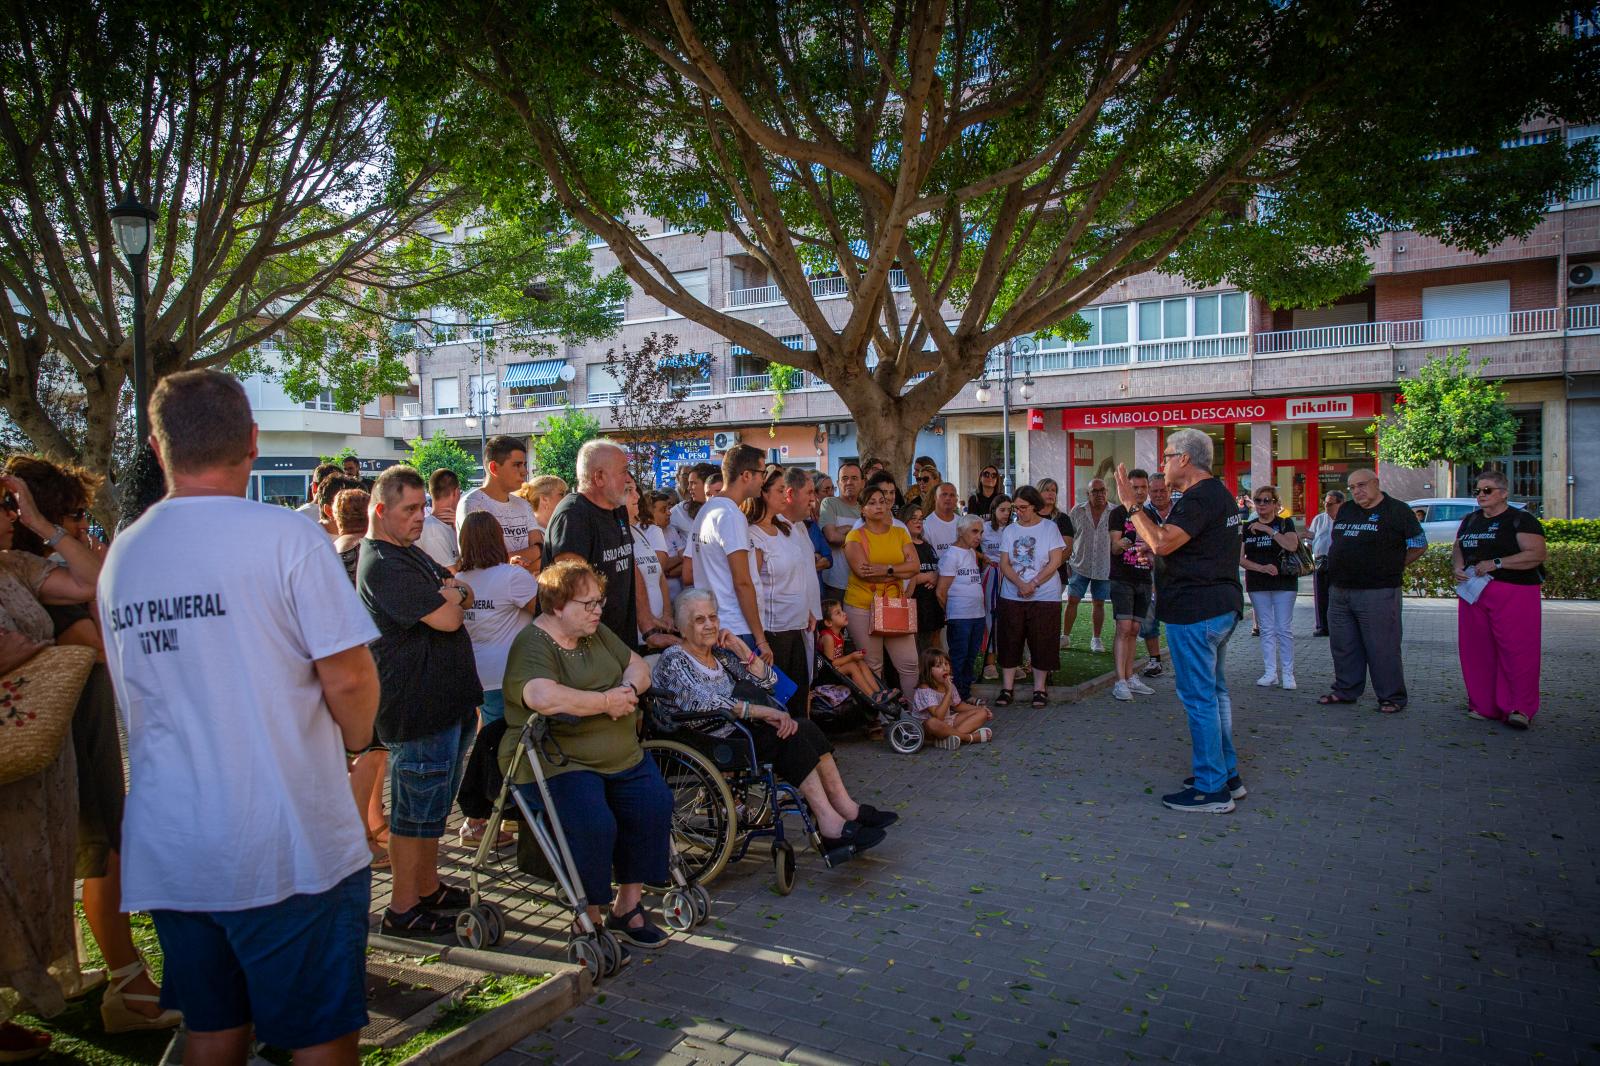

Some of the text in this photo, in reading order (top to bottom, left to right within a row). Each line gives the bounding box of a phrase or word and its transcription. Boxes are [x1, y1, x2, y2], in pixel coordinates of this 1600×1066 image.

[1084, 405, 1265, 425] EL SÍMBOLO DEL DESCANSO
[1292, 400, 1348, 417] pikolin
[699, 439, 711, 447] DE
[688, 452, 708, 460] PESO
[147, 593, 226, 623] PALMERAL
